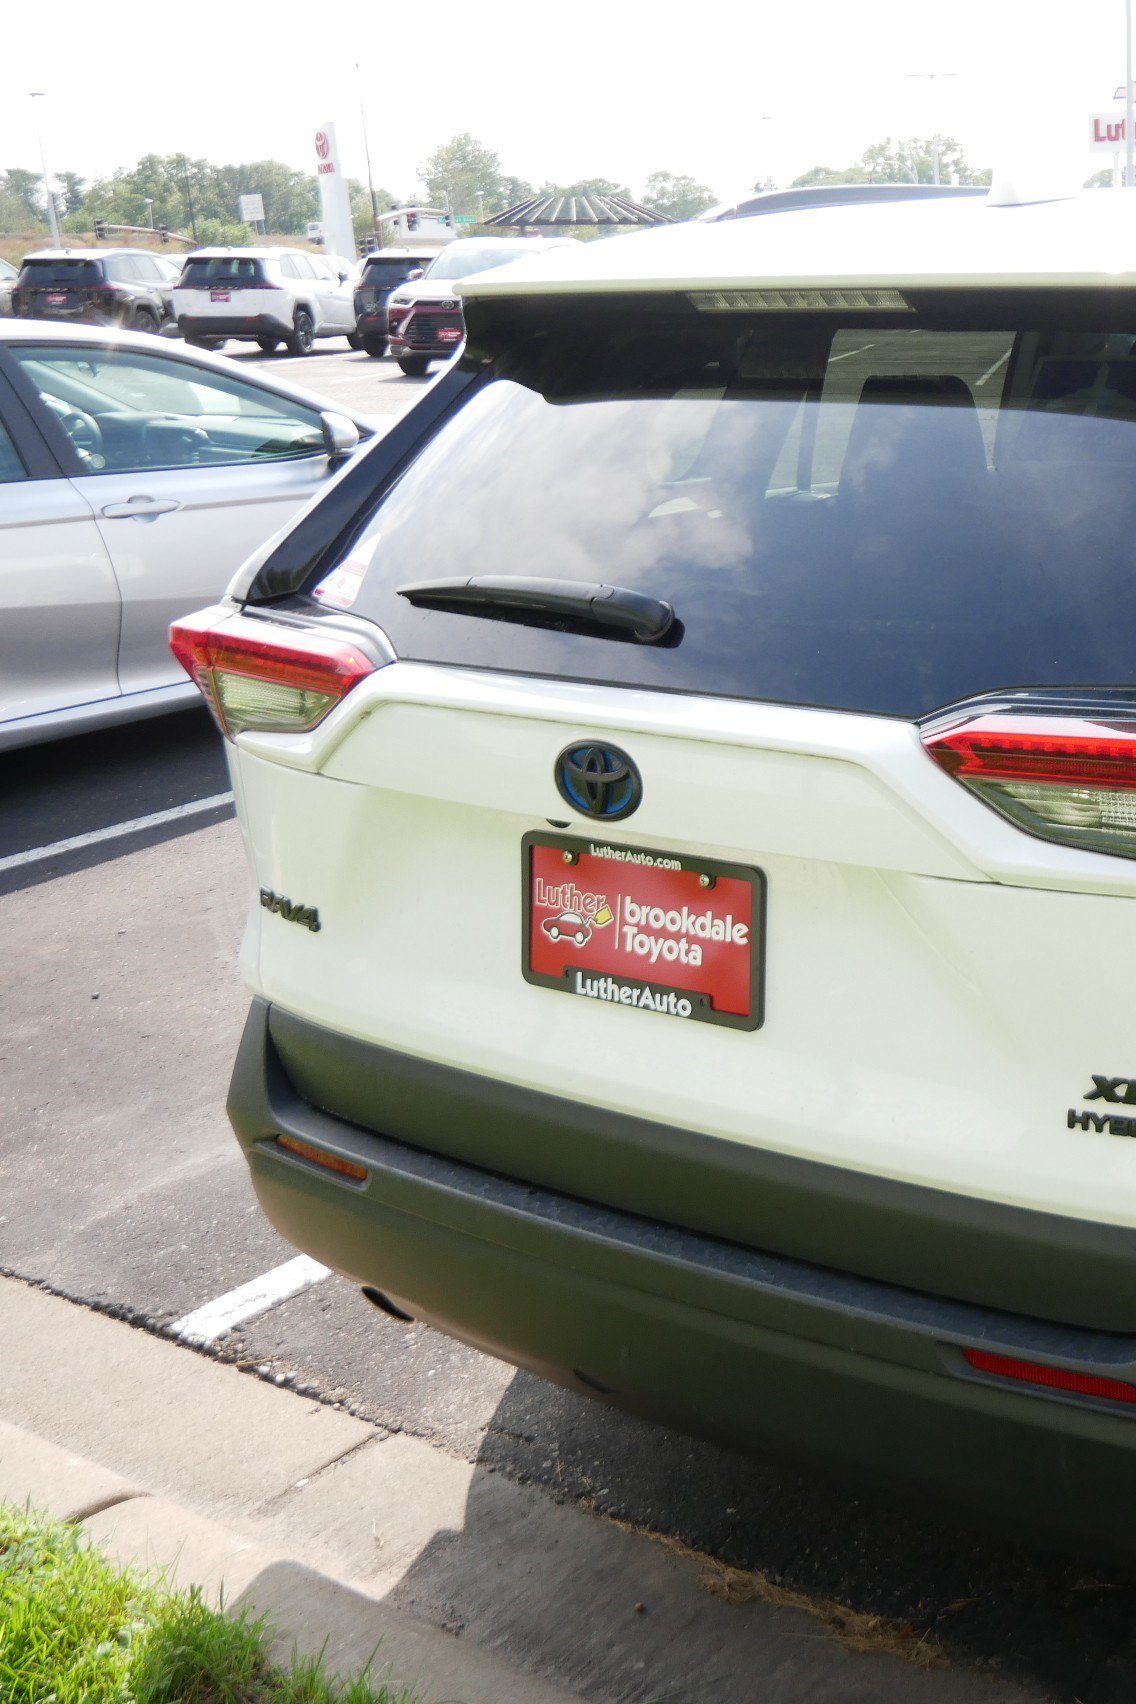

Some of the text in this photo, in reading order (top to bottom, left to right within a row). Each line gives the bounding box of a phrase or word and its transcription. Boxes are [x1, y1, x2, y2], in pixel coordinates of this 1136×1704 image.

[590, 843, 682, 871] LutherAuto.com
[536, 877, 607, 914] Luther
[624, 895, 749, 946] brookdale
[622, 925, 702, 966] Toyota
[575, 971, 693, 1017] LutherAuto
